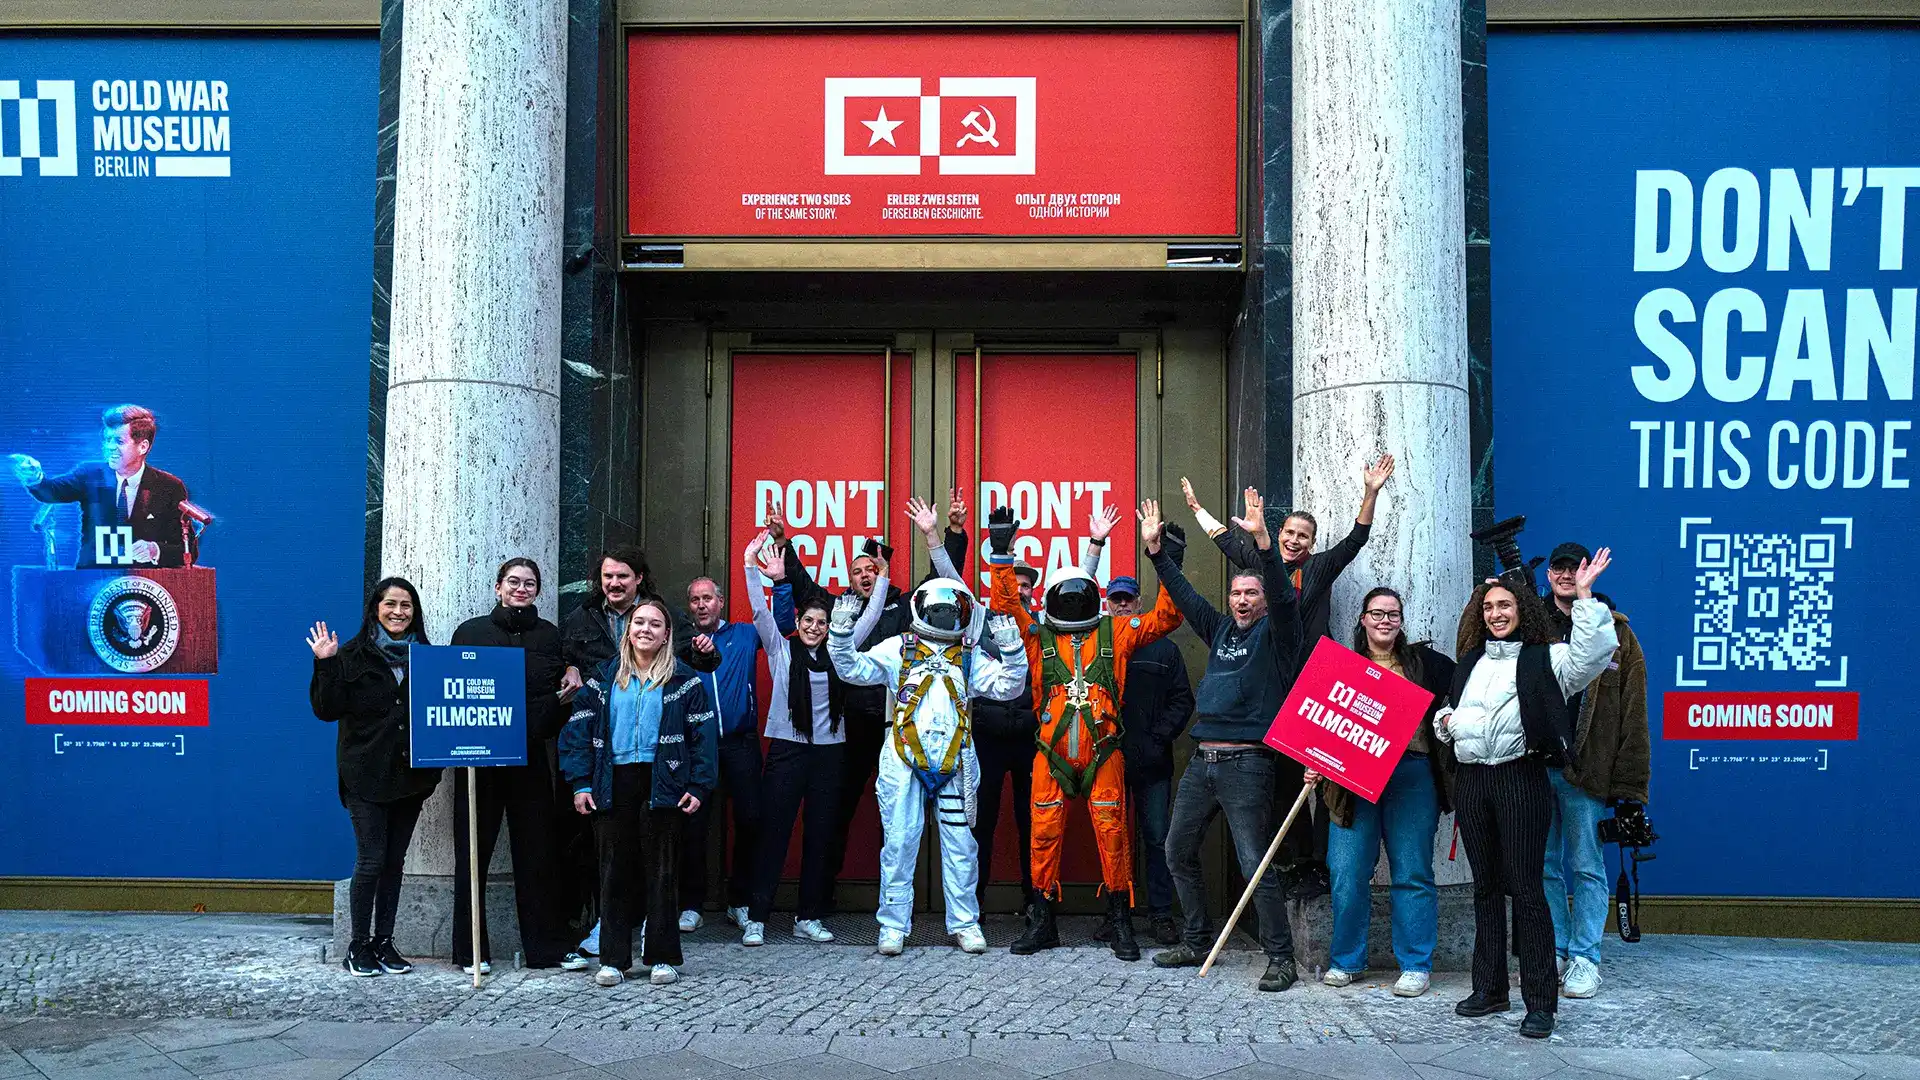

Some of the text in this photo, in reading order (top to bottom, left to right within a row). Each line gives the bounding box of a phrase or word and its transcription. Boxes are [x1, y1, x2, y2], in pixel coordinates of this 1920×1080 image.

[92, 79, 230, 112] COLD WAR
[94, 116, 230, 151] MUSEUM
[95, 156, 150, 178] BERLIN
[741, 194, 852, 206] EXPERIENCE TWO SIDES
[887, 194, 980, 206] ERLEBE ZWEI SEITEN
[1015, 194, 1121, 207] ОПЫТ ДВУХ СТОРОН
[755, 208, 838, 220] OF THE SAME STORY.
[882, 208, 984, 220] DERSELBEN GESCHICHTE.
[1029, 204, 1110, 220] ОДНОЙ ИСТОРИИ
[1633, 167, 1920, 273] DON'T
[1631, 288, 1918, 402] SCAN
[1630, 420, 1911, 490] THIS CODE
[755, 480, 885, 529] DON'T
[980, 481, 1111, 530] DON'T
[143, 582, 155, 592] THE
[91, 580, 130, 626] PRESIDENT
[156, 590, 178, 631] UNITED
[146, 638, 175, 667] STATES
[466, 678, 495, 686] COLD WAR
[466, 685, 495, 694] MUSEUM
[49, 690, 186, 714] COMING SOON
[1352, 699, 1385, 720] MUSEUM
[1356, 692, 1387, 713] COLD WAR
[426, 706, 513, 727] FILMCREW
[1688, 704, 1834, 728] COMING SOON
[1297, 697, 1391, 759] FILMCREW
